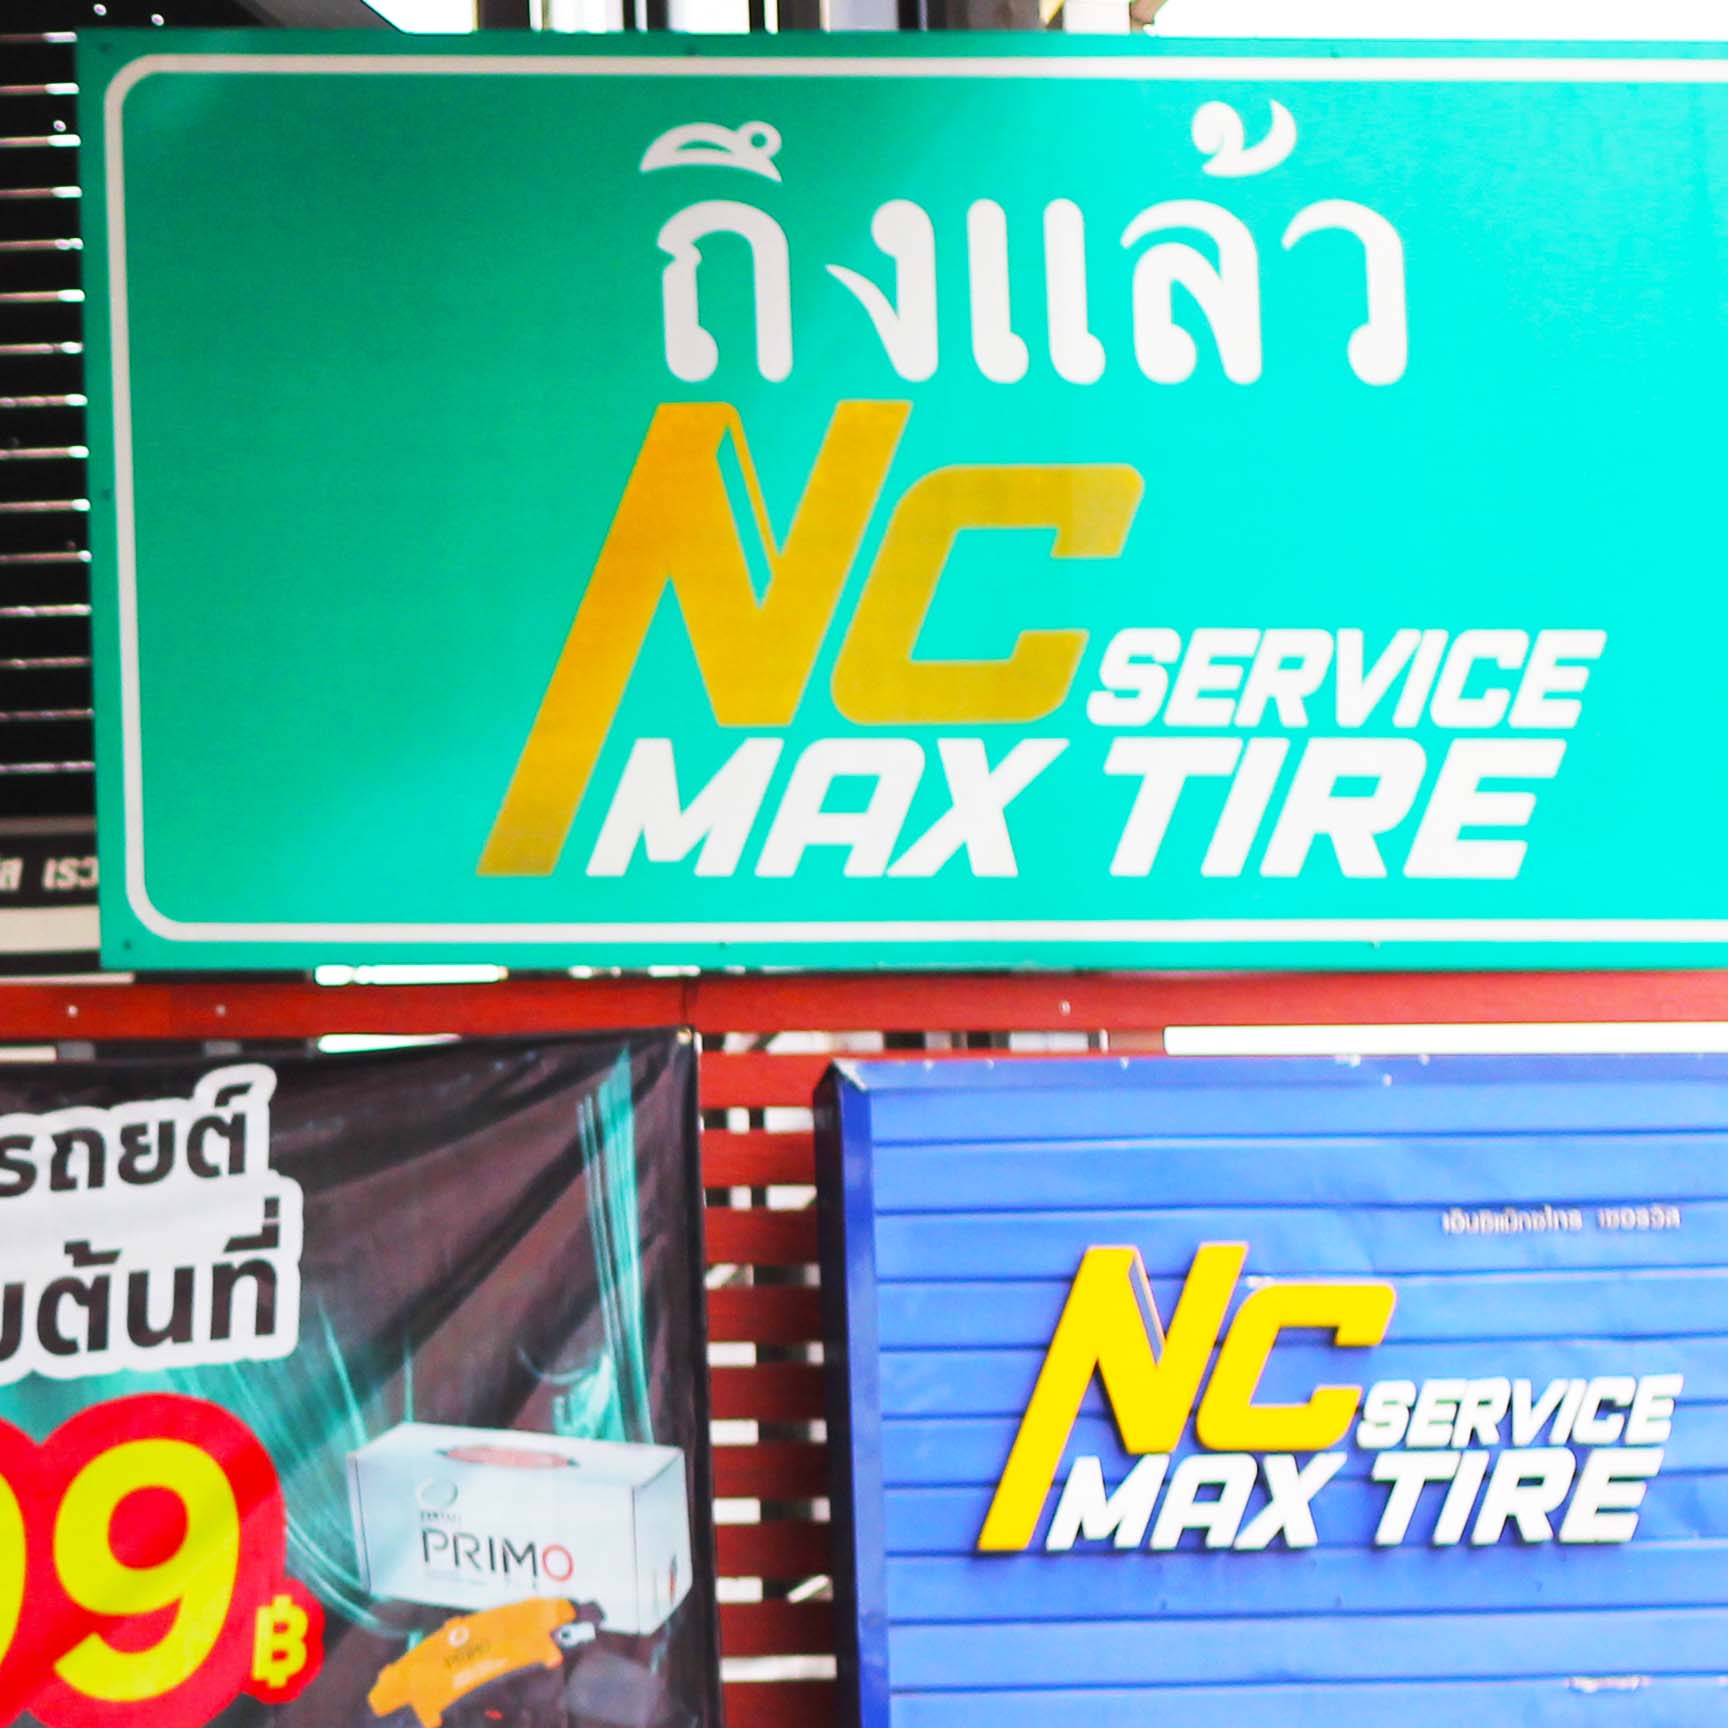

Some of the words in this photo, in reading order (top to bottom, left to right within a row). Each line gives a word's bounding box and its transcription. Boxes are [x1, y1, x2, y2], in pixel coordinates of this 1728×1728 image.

[639, 99, 1409, 387] ถึงแล้ว
[475, 398, 1146, 878] NC
[1085, 627, 1608, 731] SERVICE
[585, 736, 1070, 880] MAX
[1101, 736, 1568, 880] TIRE
[978, 1241, 1397, 1551] NC
[1356, 1374, 1685, 1450] SERVICE
[1046, 1451, 1348, 1552] MAX
[1370, 1448, 1665, 1547] TIRE
[421, 1527, 575, 1583] PRIMO
